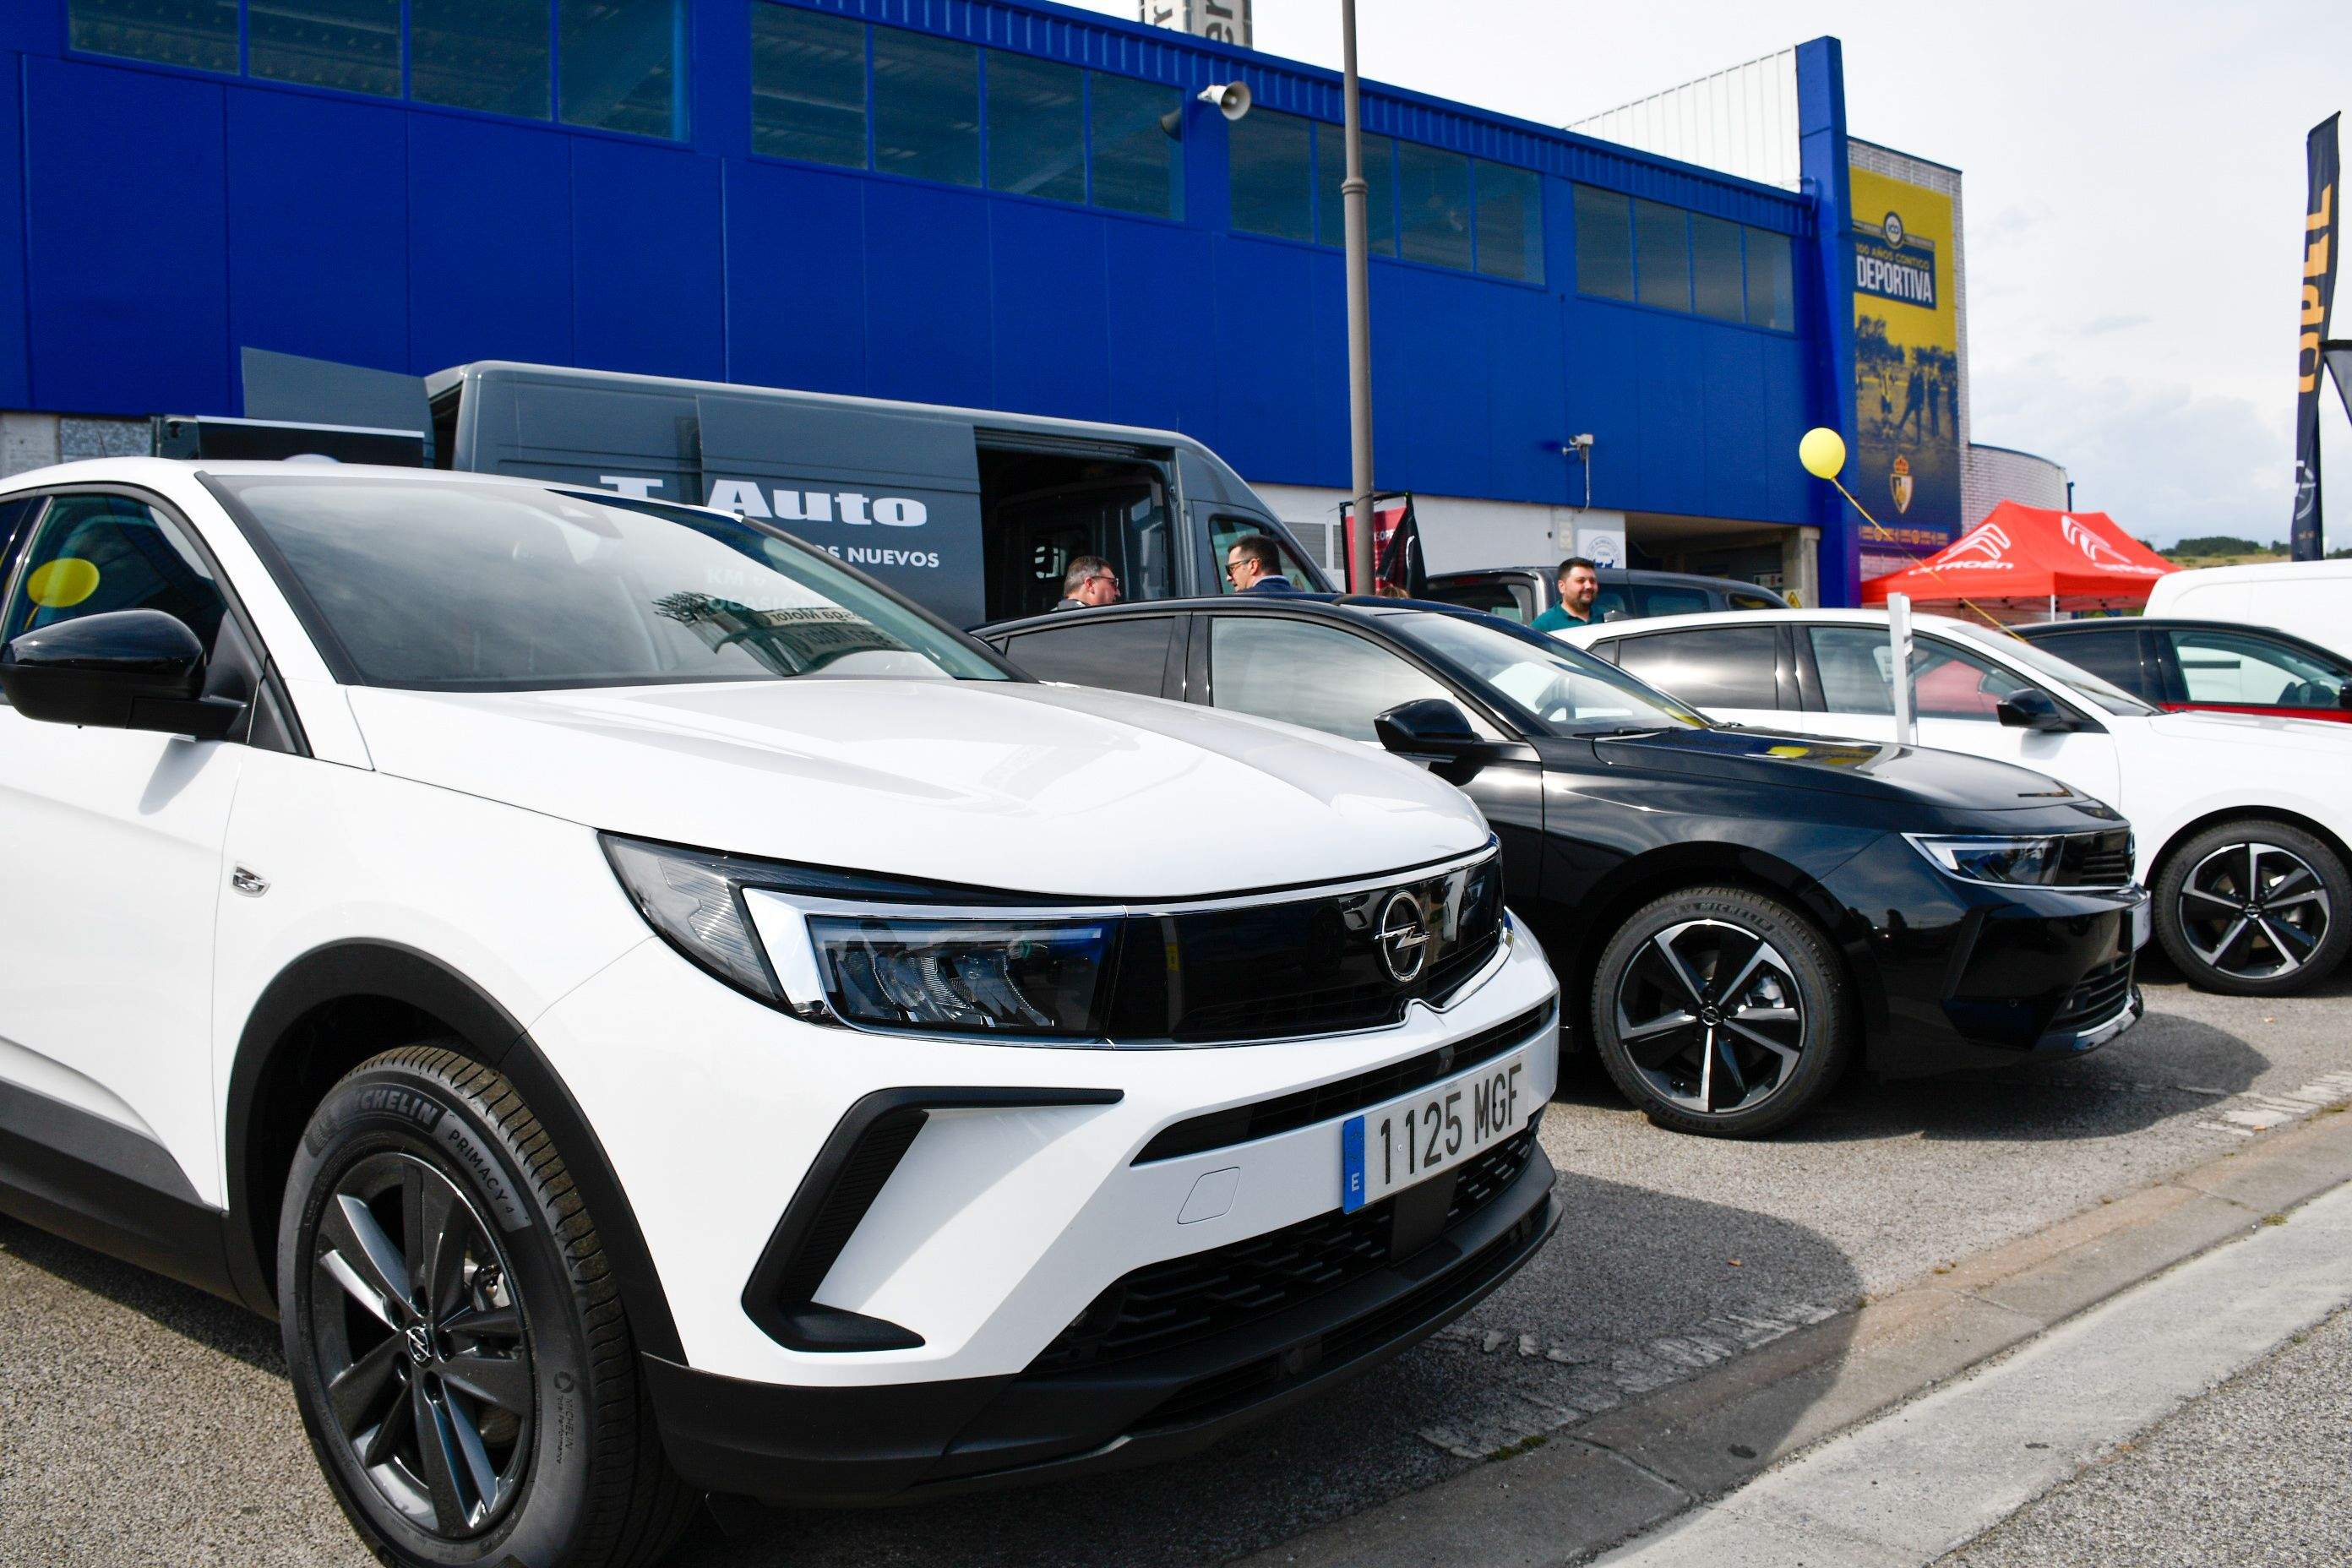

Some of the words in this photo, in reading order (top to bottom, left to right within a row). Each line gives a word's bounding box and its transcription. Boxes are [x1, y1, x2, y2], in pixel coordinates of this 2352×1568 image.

[1855, 254, 1933, 303] DEPORTIVA
[707, 479, 928, 528] Auto
[848, 547, 940, 569] NUEVOS
[1380, 1091, 1463, 1185] 1125
[1474, 1063, 1522, 1145] MGF
[448, 1128, 509, 1201] PRIMACY
[1351, 1172, 1360, 1192] E
[564, 1398, 575, 1451] MICHELIN
